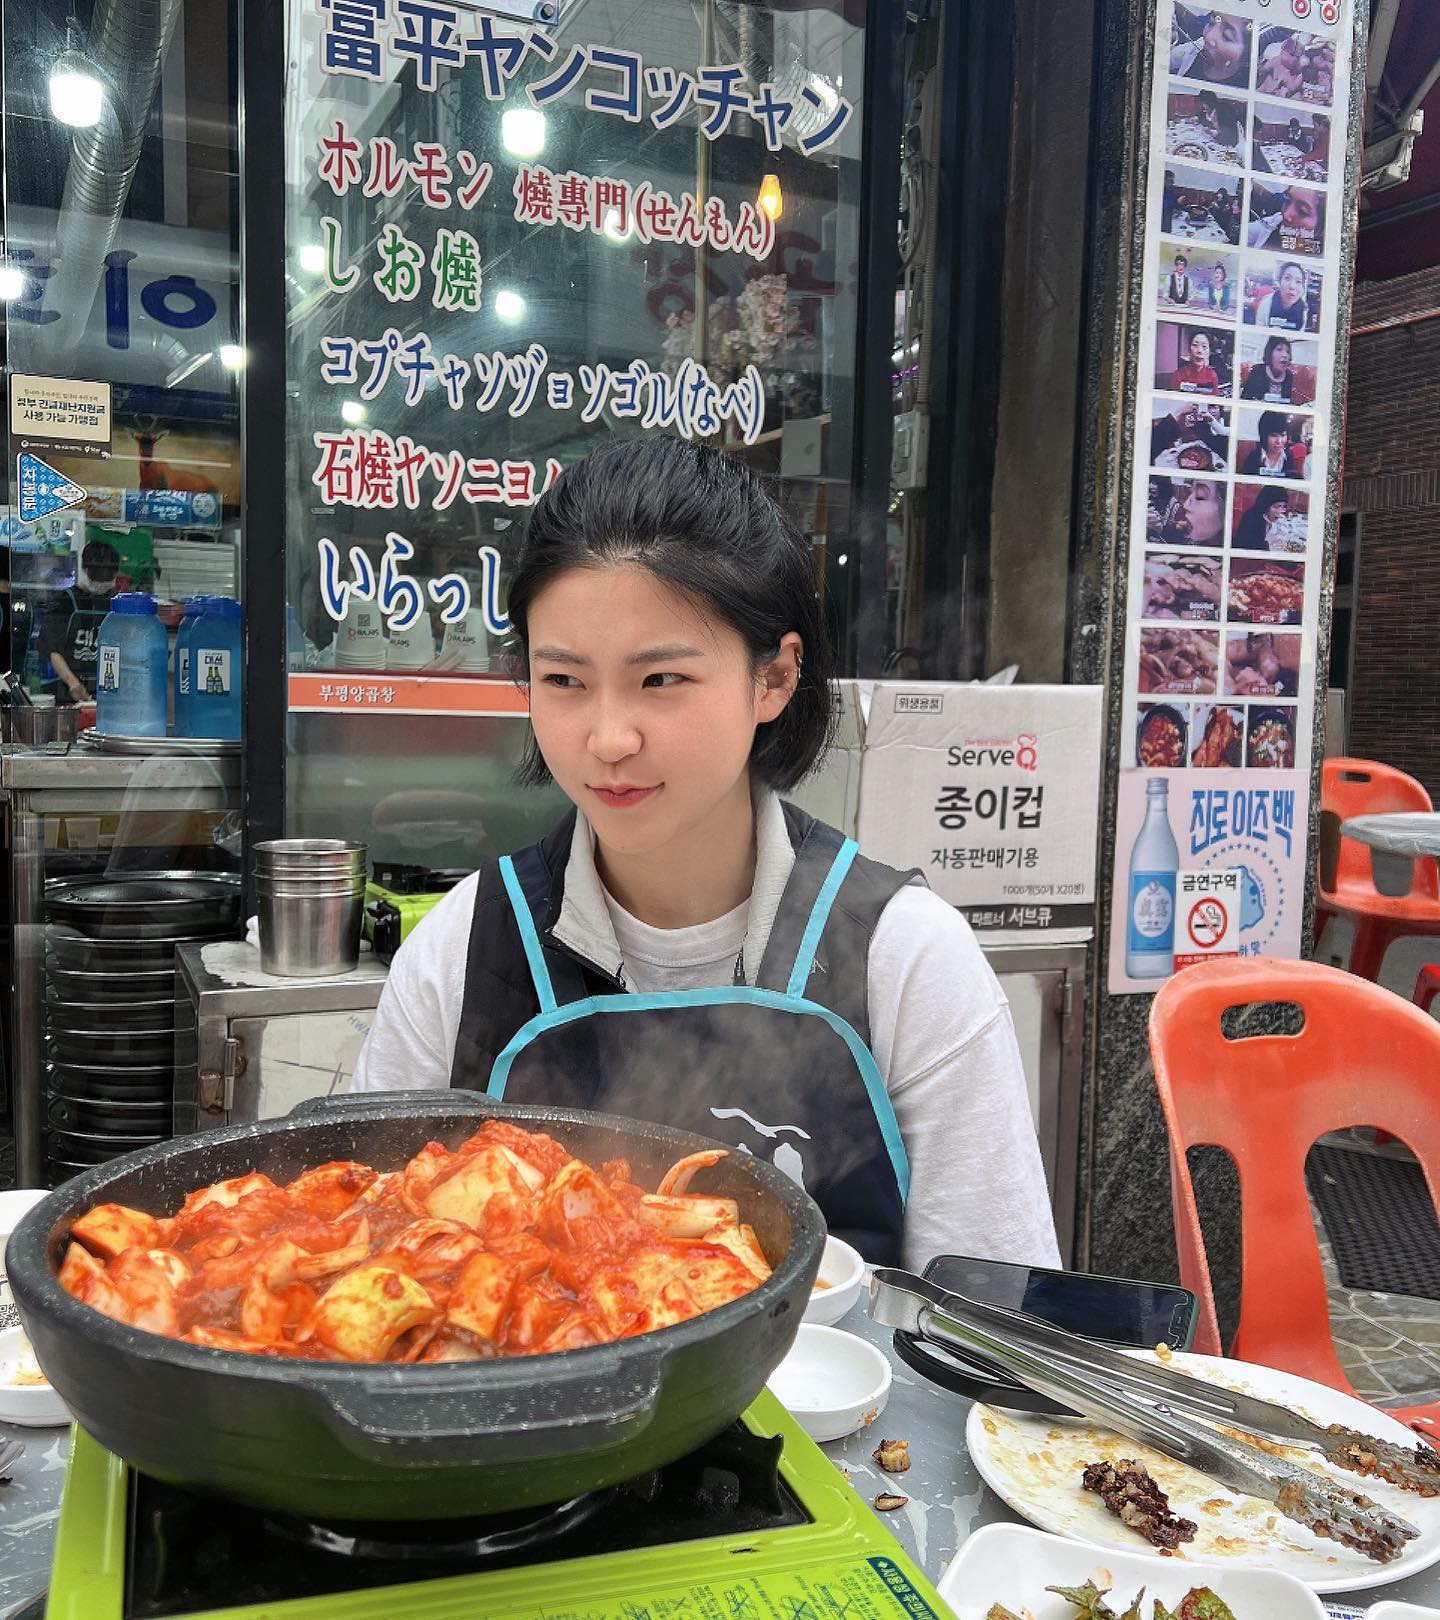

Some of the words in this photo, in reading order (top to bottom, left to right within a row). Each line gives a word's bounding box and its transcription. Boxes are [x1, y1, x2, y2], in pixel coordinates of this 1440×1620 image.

[321, 121, 491, 205] ホルモン
[322, 535, 511, 632] いらっし
[319, 684, 396, 704] 부평양곱창
[934, 785, 1044, 830] 종이컵
[1189, 788, 1295, 858] 진로이즈백
[930, 847, 1040, 870] 자동판매기용
[1182, 873, 1237, 891] 금연구역
[1008, 906, 1053, 926] 서브큐
